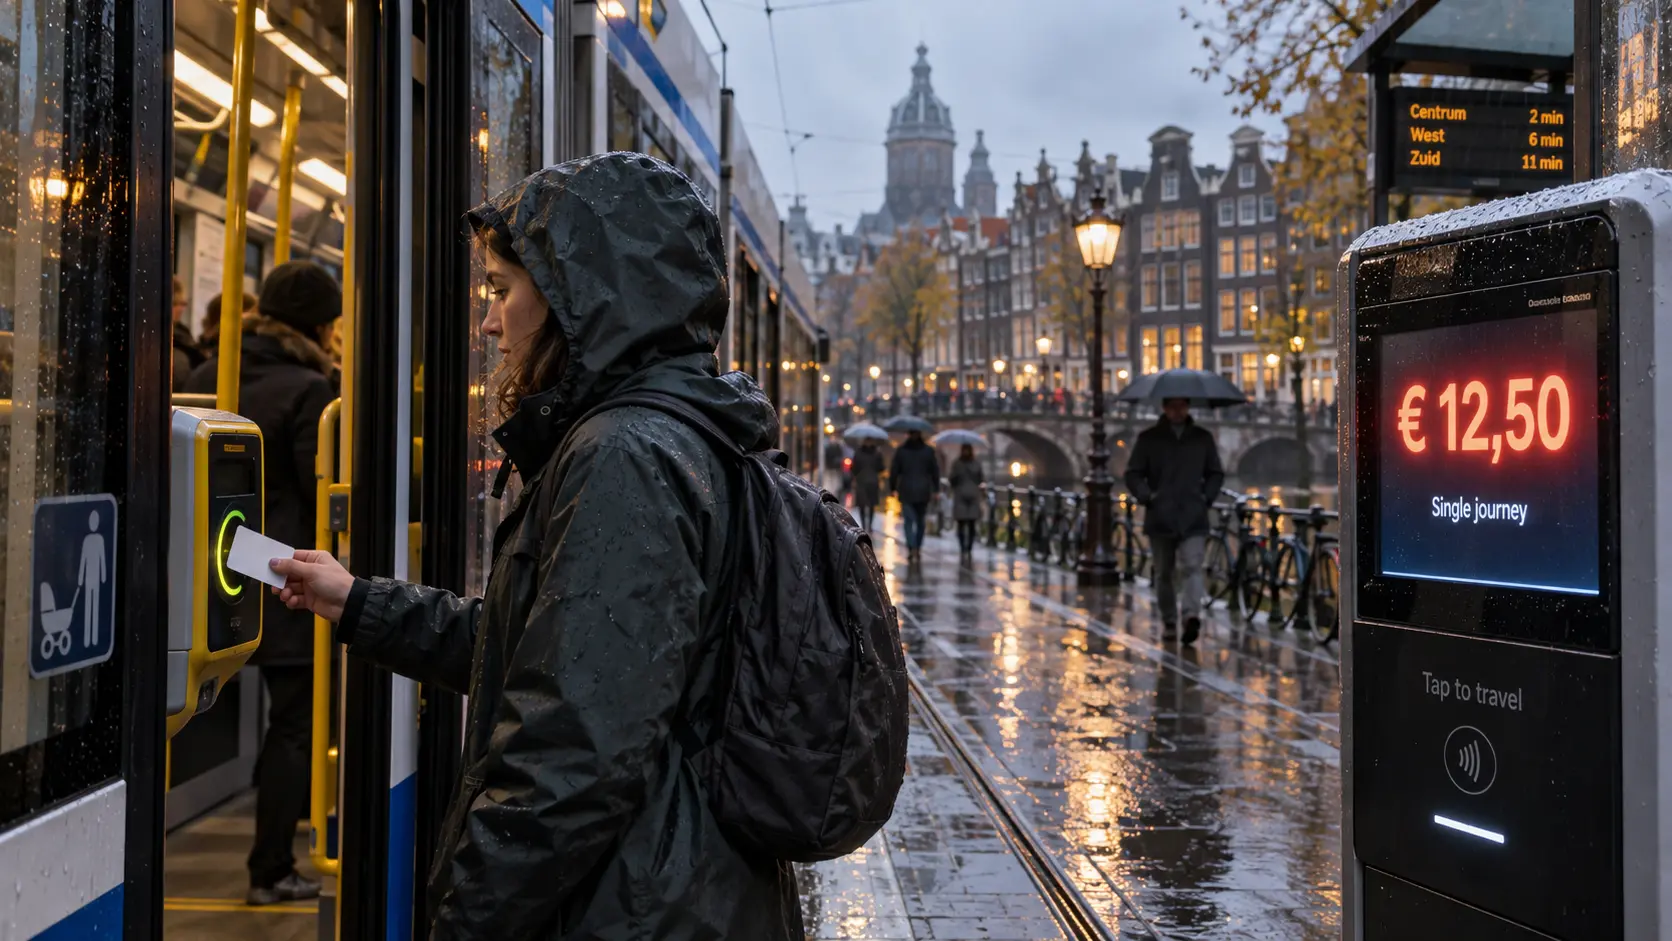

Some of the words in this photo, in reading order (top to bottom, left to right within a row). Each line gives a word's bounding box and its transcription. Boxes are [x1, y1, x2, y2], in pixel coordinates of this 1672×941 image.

[1409, 103, 1467, 121] Centrum
[1529, 109, 1538, 124] 2
[1540, 110, 1564, 125] min
[1410, 127, 1445, 143] West
[1529, 132, 1538, 147] 6
[1540, 133, 1564, 147] min
[1410, 150, 1441, 166] Zuid
[1522, 155, 1536, 169] 11
[1540, 156, 1563, 170] min
[1397, 384, 1427, 453] €
[1439, 374, 1571, 464] 12,50
[1431, 496, 1471, 523] Single
[1473, 497, 1528, 526] journey
[1422, 670, 1450, 702] Tap
[1454, 678, 1471, 701] to
[1475, 682, 1522, 711] travel
